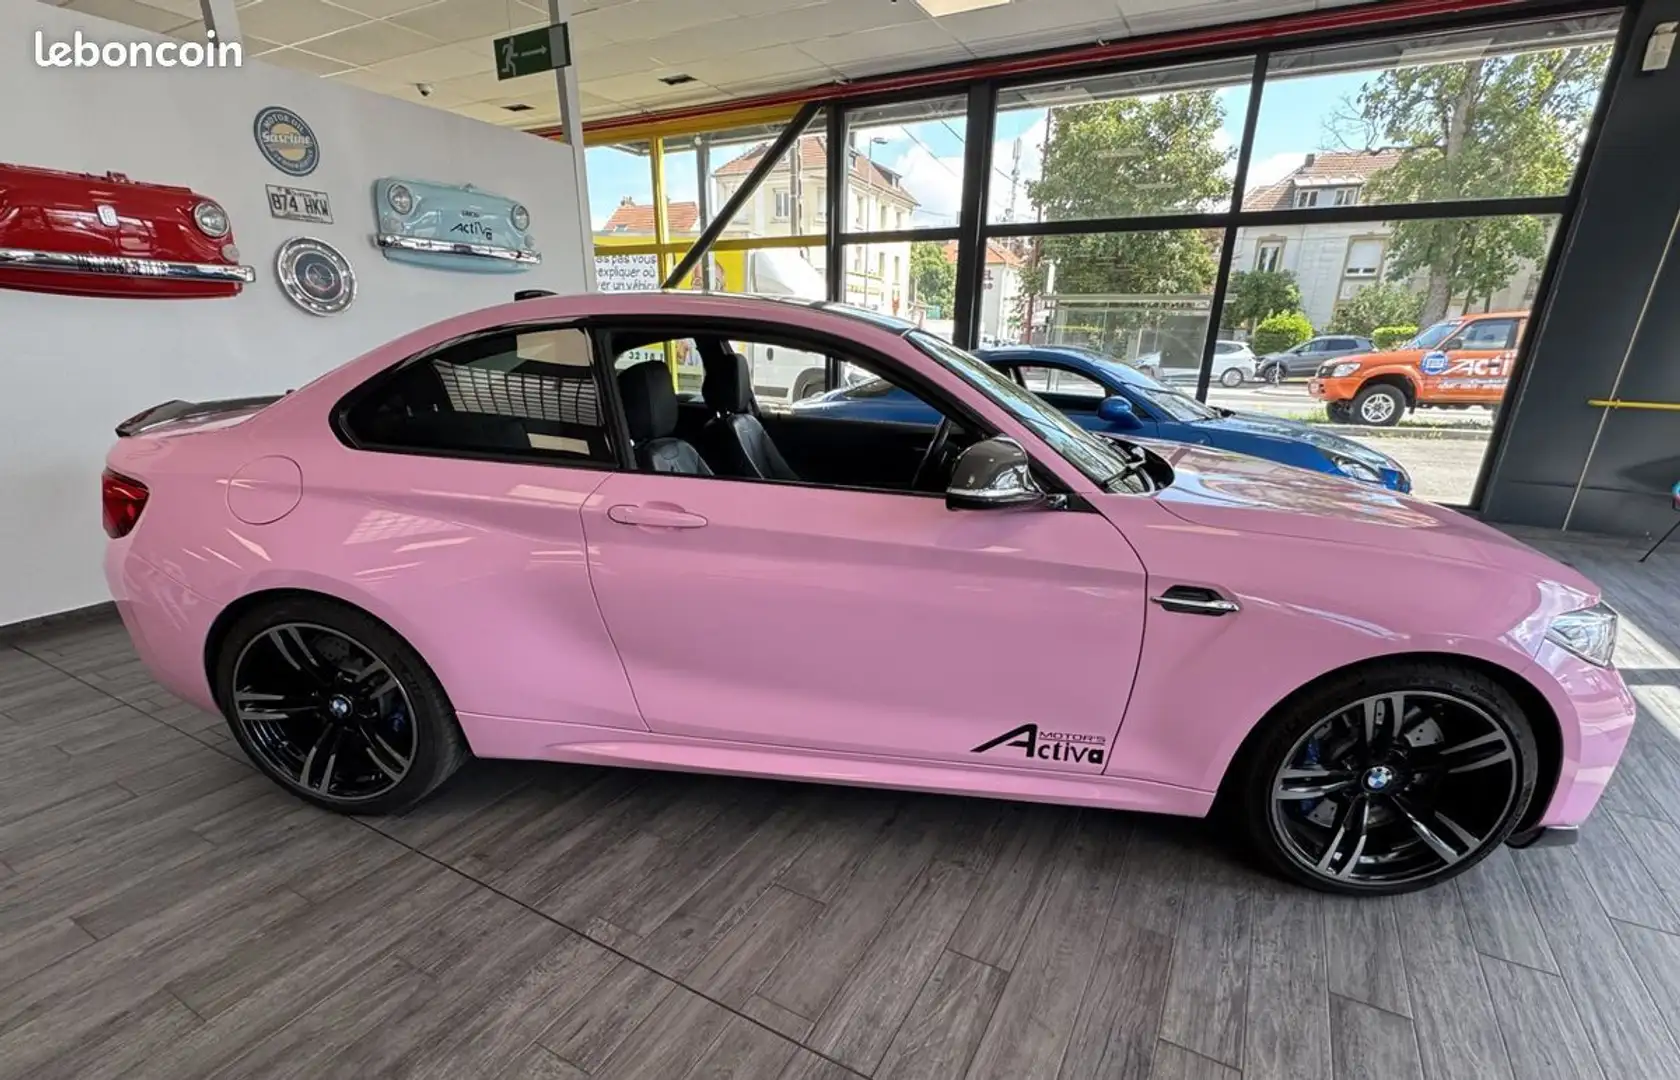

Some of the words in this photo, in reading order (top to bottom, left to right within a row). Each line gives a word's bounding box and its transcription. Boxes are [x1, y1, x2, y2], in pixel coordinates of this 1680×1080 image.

[304, 197, 329, 216] HKW
[632, 255, 657, 265] vous
[598, 266, 641, 280] expliquer
[970, 723, 1105, 764] Activa
